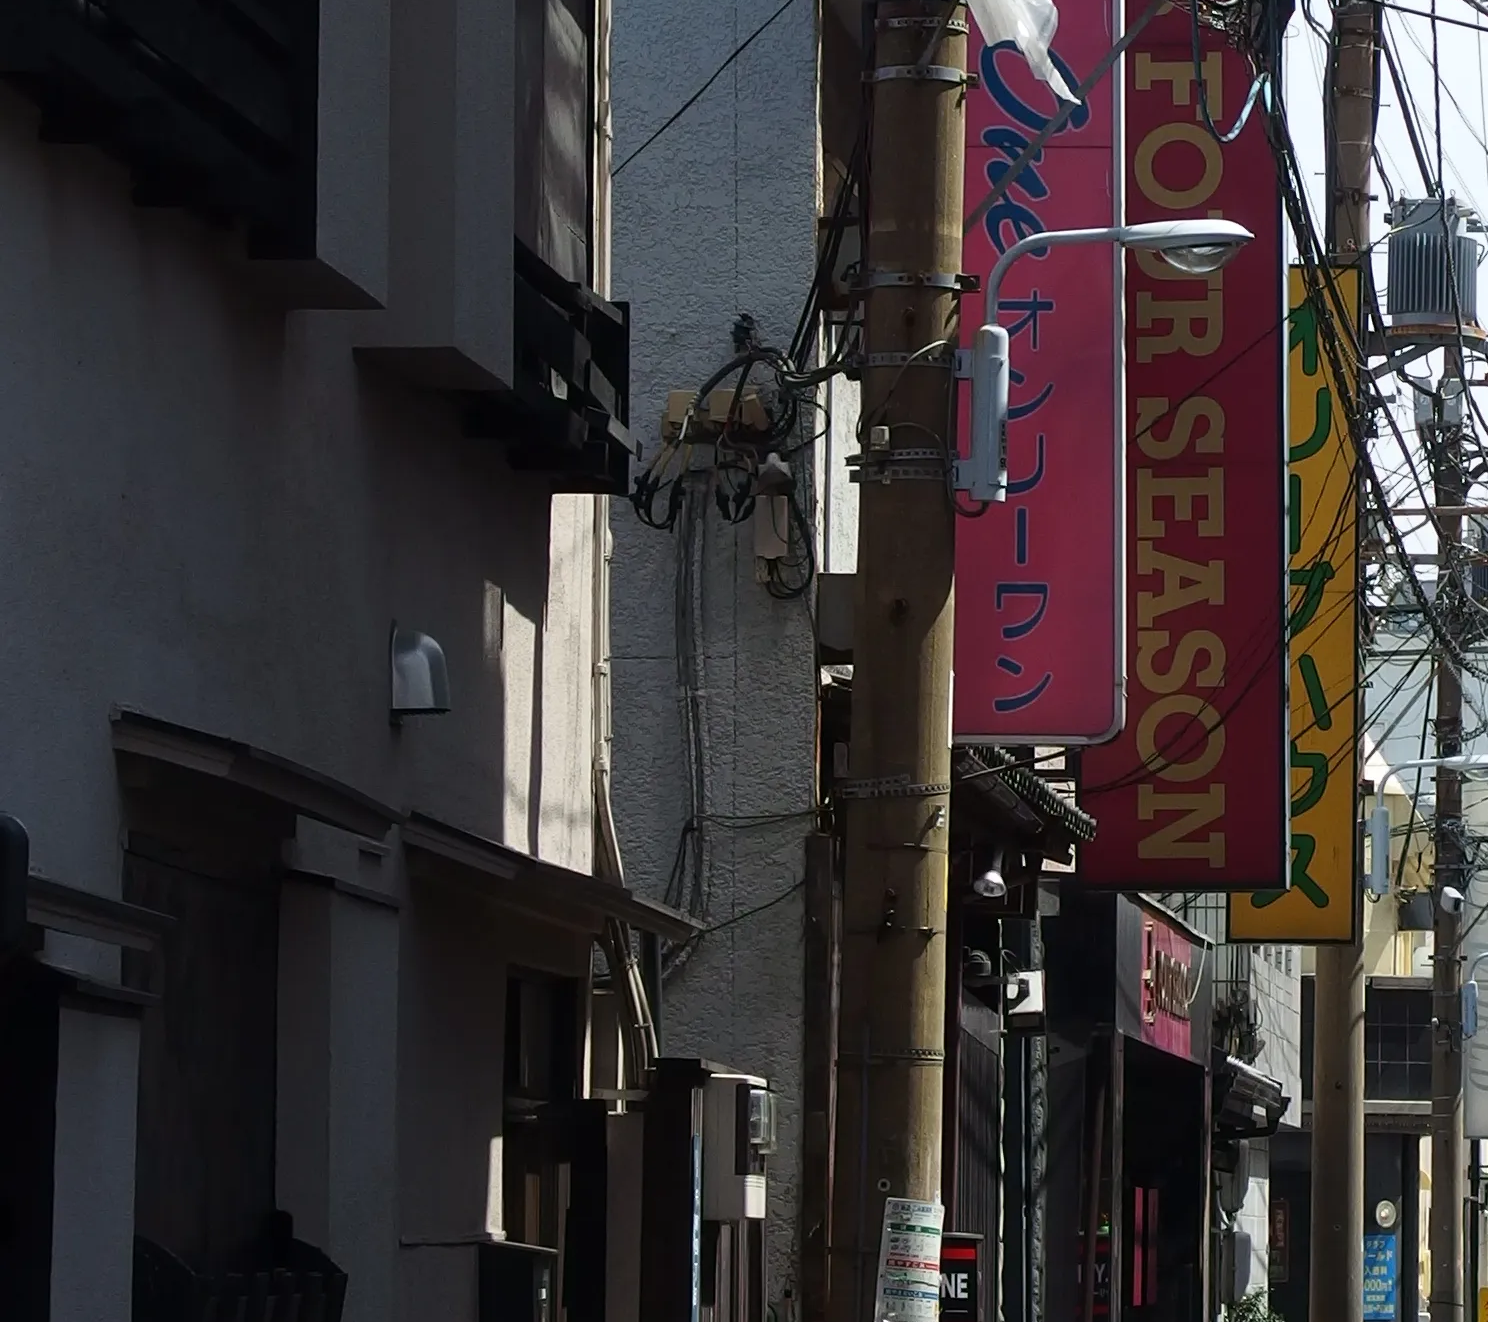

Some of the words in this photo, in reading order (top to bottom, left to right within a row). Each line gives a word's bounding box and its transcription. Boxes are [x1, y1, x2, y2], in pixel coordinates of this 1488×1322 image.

[989, 288, 1055, 715] オンリーワン
[1136, 395, 1226, 869] SEASON
